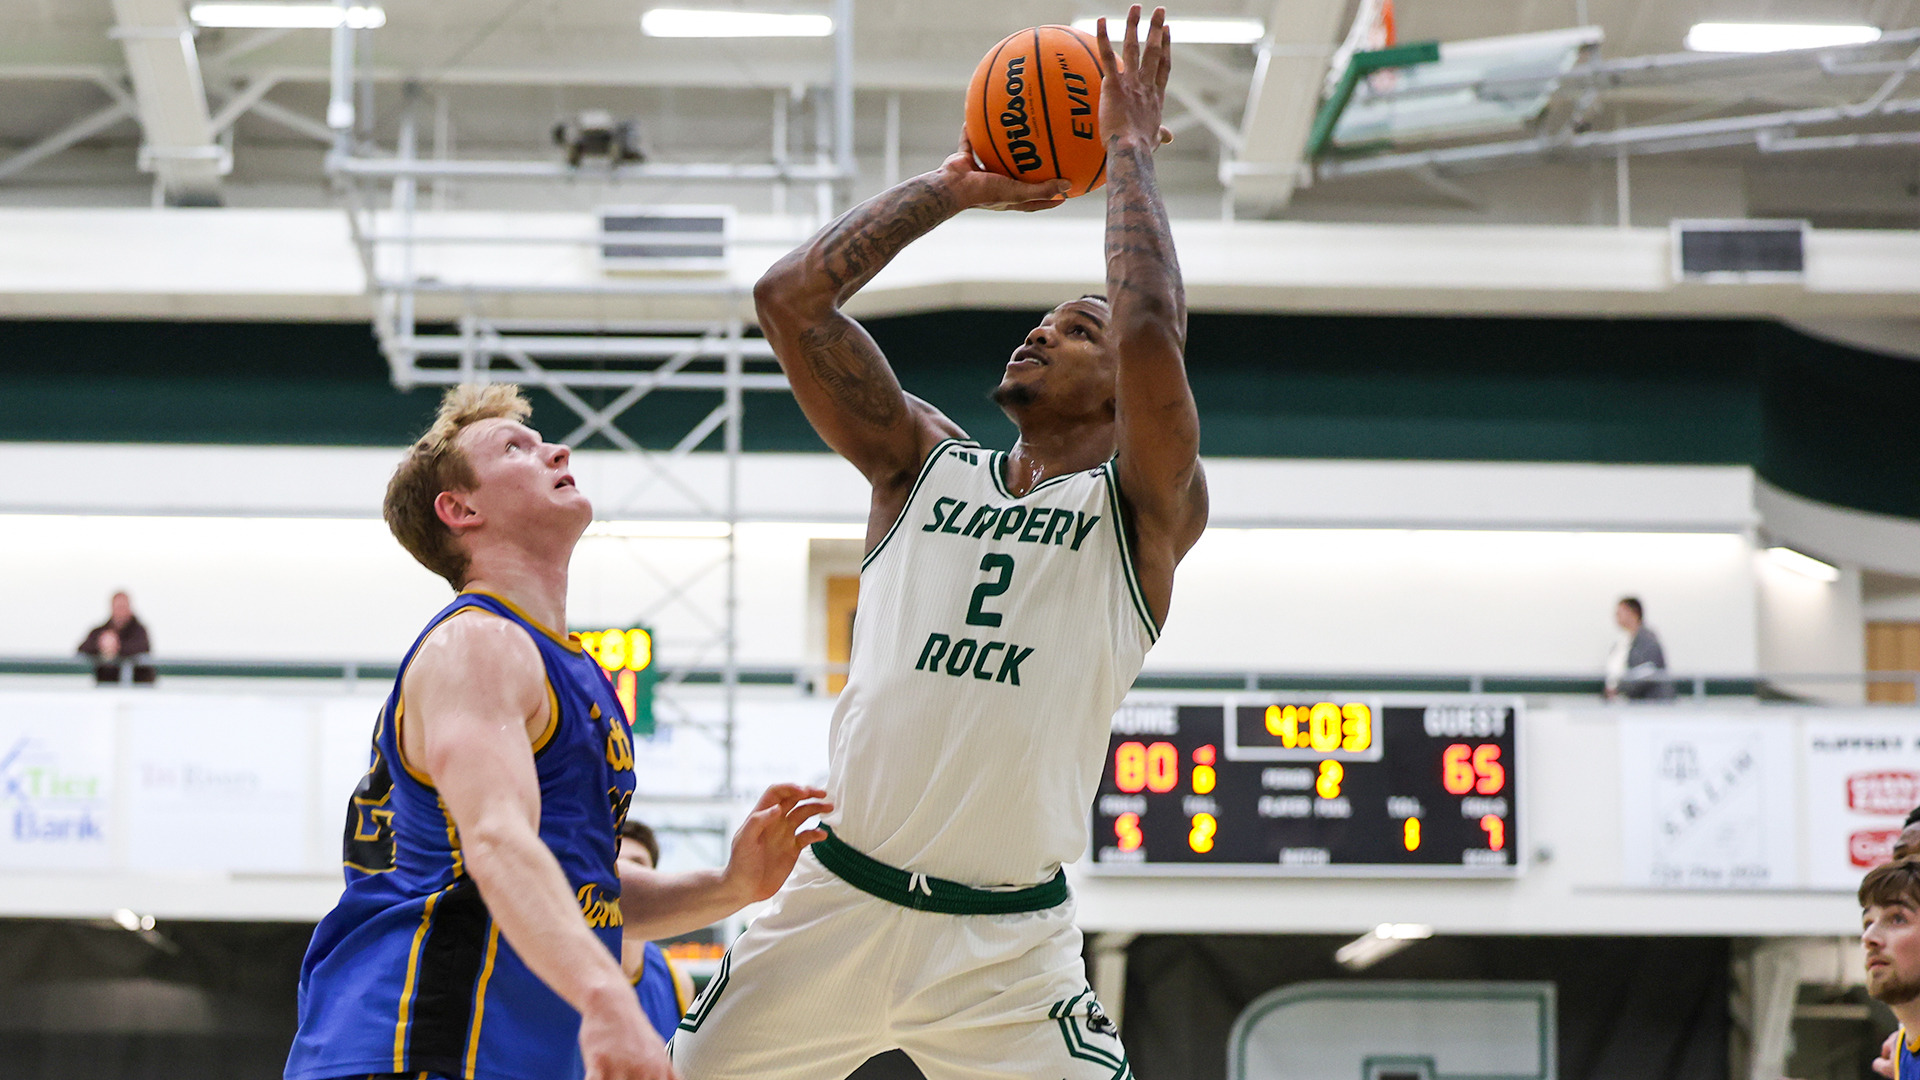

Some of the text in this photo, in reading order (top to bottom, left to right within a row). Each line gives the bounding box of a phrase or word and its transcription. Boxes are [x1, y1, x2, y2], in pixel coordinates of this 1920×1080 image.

[1000, 56, 1042, 174] Wilson
[922, 496, 1101, 551] SLIPPERY
[965, 553, 1015, 627] 2
[915, 633, 1035, 686] ROCK
[1265, 702, 1372, 752] 4:03
[1424, 706, 1509, 737] GUEST
[1115, 742, 1178, 793] 80
[1316, 759, 1344, 799] 2
[1442, 744, 1505, 794] 65
[12, 806, 103, 842] Bank
[1114, 812, 1143, 852] 5
[1188, 812, 1217, 853] 2
[1404, 817, 1420, 851] 1
[1480, 814, 1504, 851] 7
